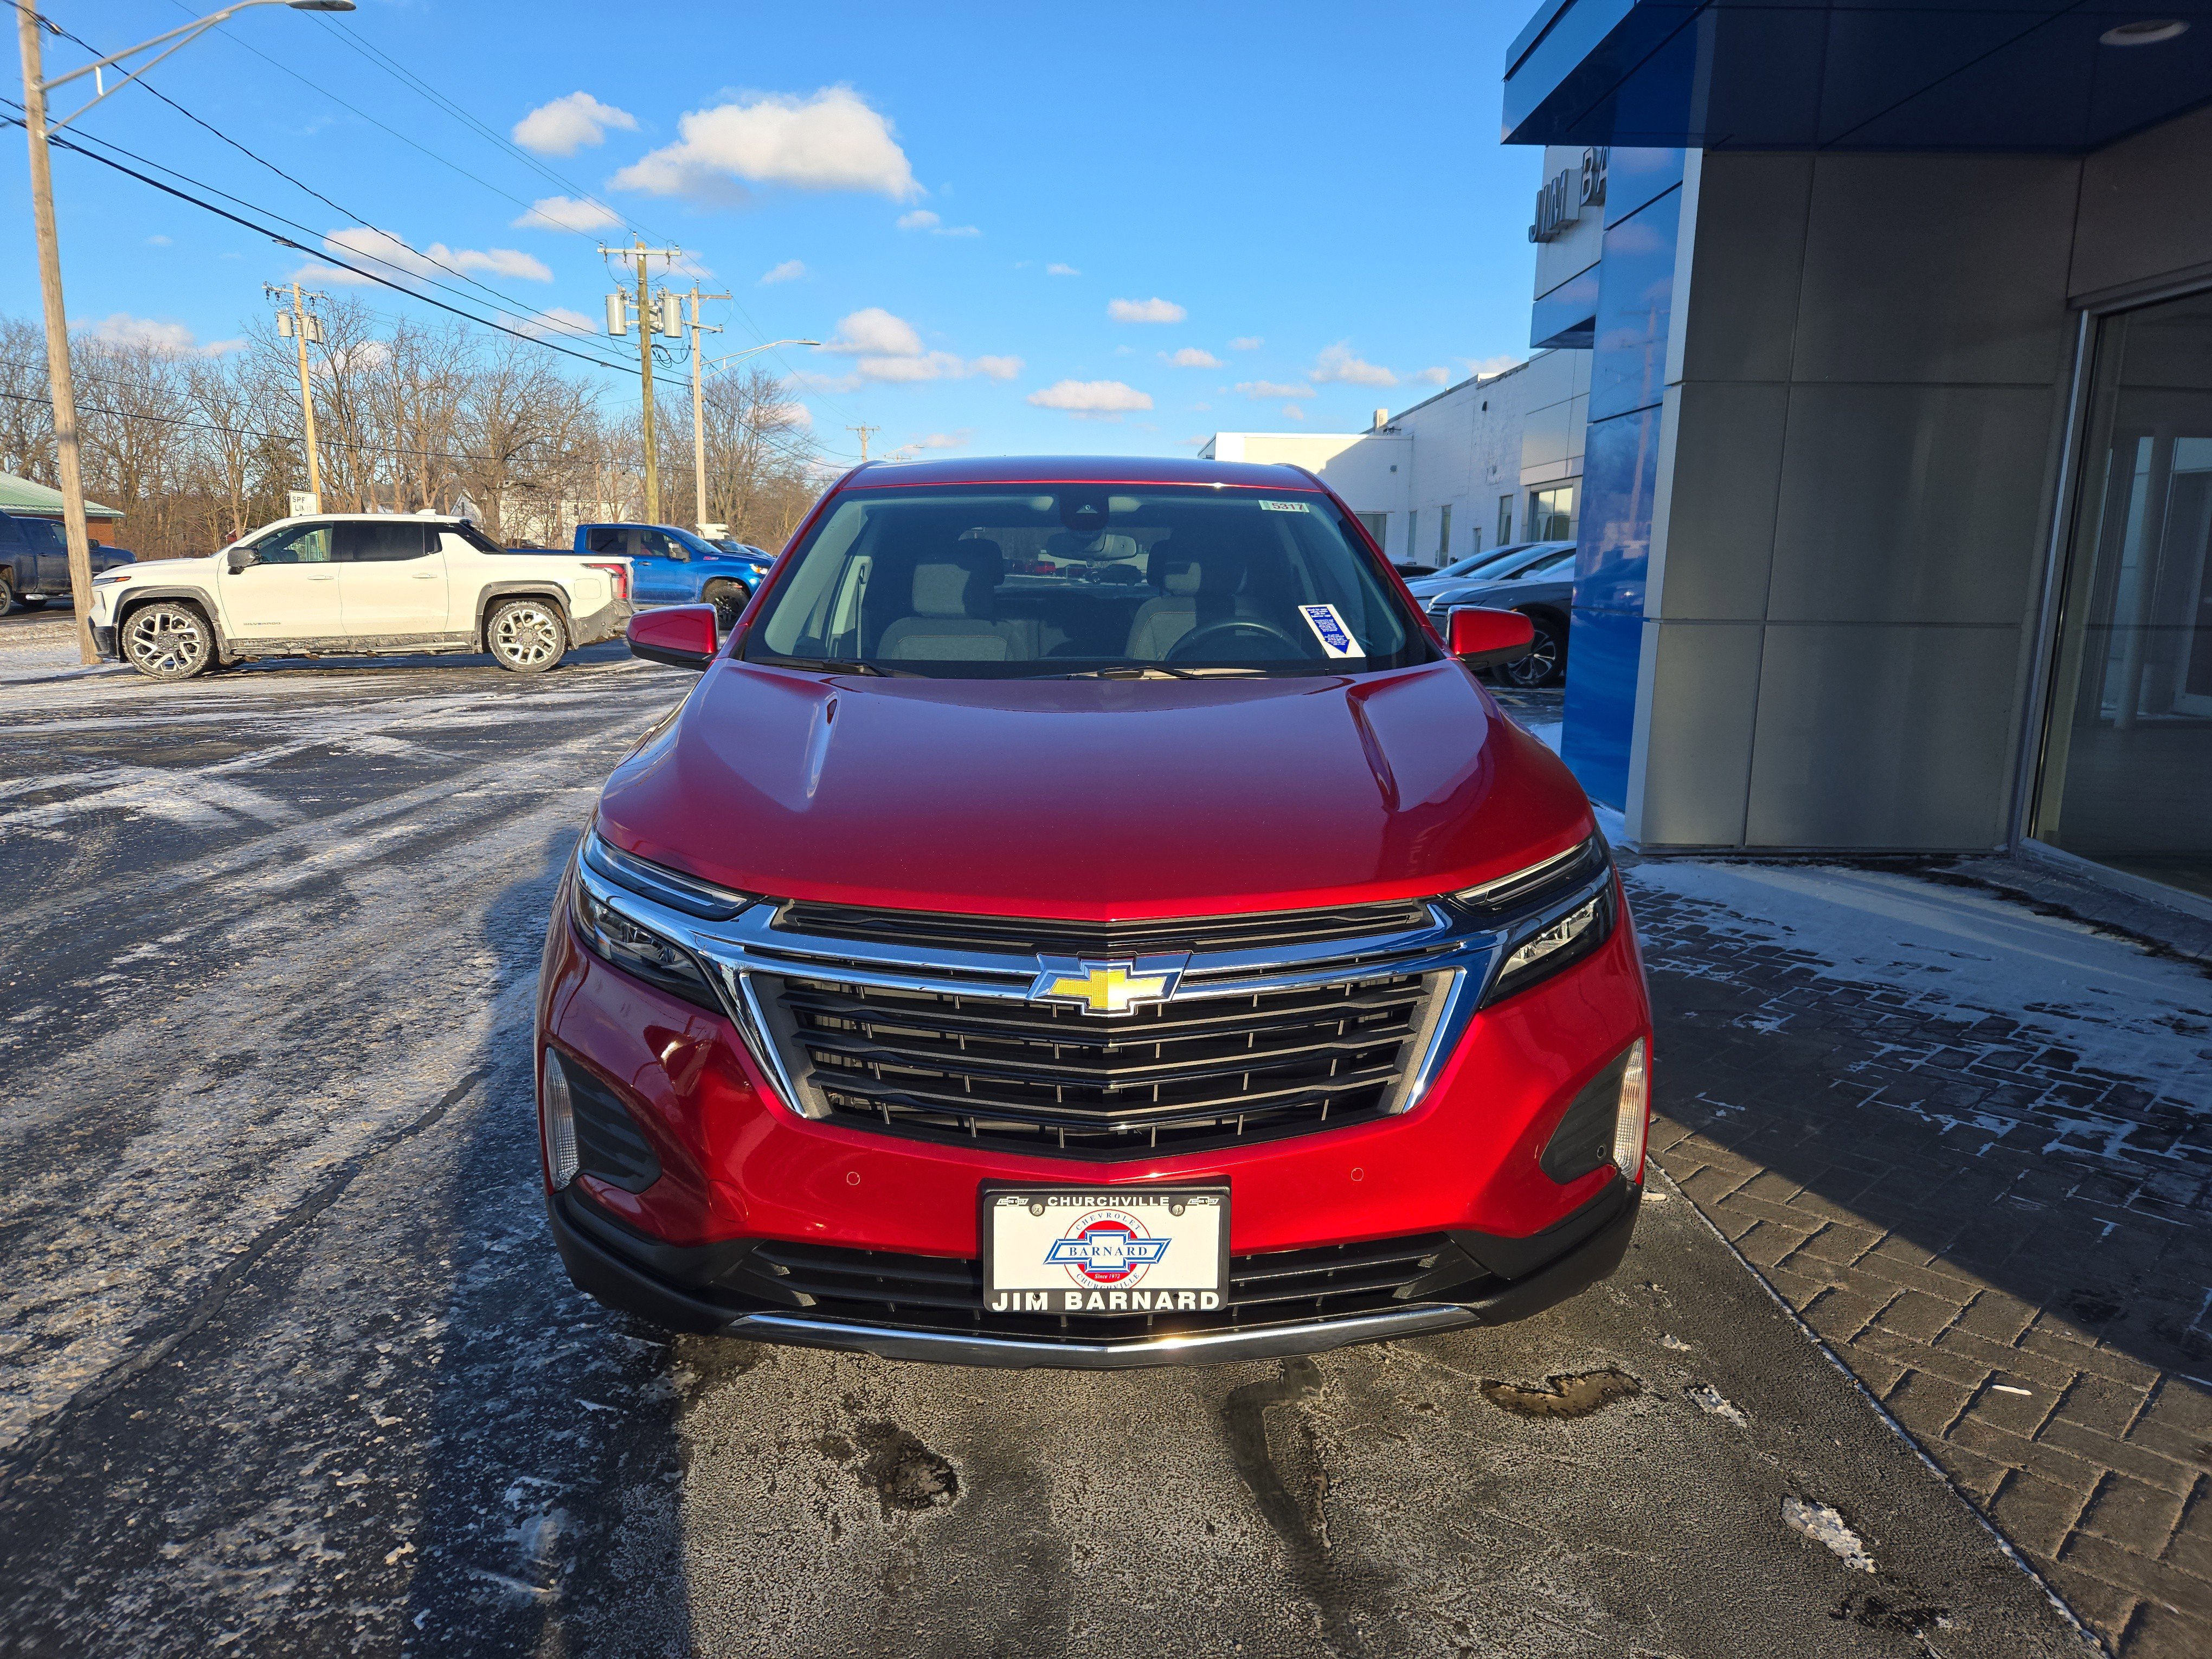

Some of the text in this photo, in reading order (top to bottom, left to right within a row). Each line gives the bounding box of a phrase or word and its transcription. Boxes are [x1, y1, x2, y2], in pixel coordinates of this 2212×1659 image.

[1528, 169, 1573, 243] JIM
[1271, 502, 1303, 511] 5317
[1047, 1196, 1169, 1207] CHURCHVILLE
[1076, 1212, 1141, 1231] CHEVROLET
[1069, 1246, 1147, 1256] BARNARD
[1076, 1272, 1140, 1289] CHURCHVILLE
[992, 1291, 1220, 1311] JIM BARNARD
